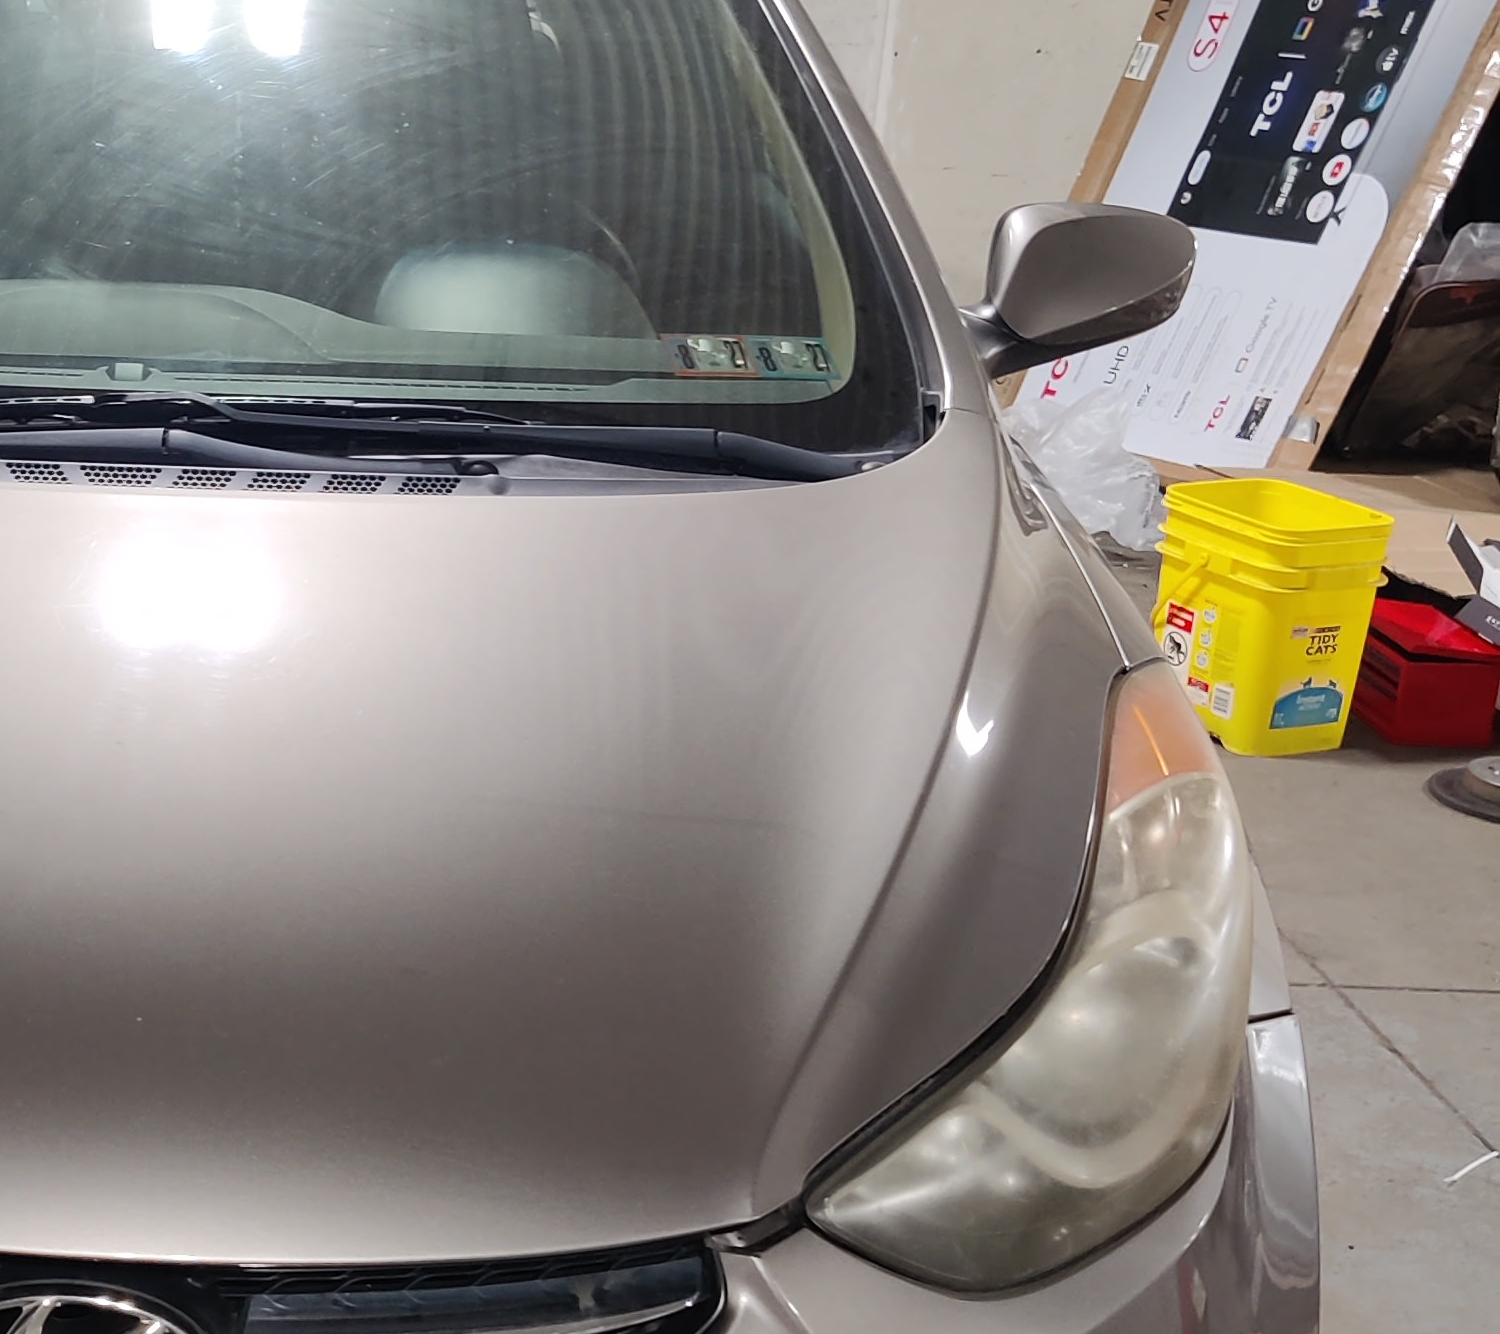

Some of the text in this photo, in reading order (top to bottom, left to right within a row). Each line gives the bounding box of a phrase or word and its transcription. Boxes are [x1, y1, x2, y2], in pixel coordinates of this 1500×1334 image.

[1193, 11, 1230, 59] S4
[1249, 70, 1294, 138] TCL
[1040, 357, 1069, 399] TC
[1103, 344, 1129, 385] UHD
[1204, 394, 1230, 432] TCL
[1305, 644, 1338, 656] CATS
[1309, 633, 1339, 646] TIDY
